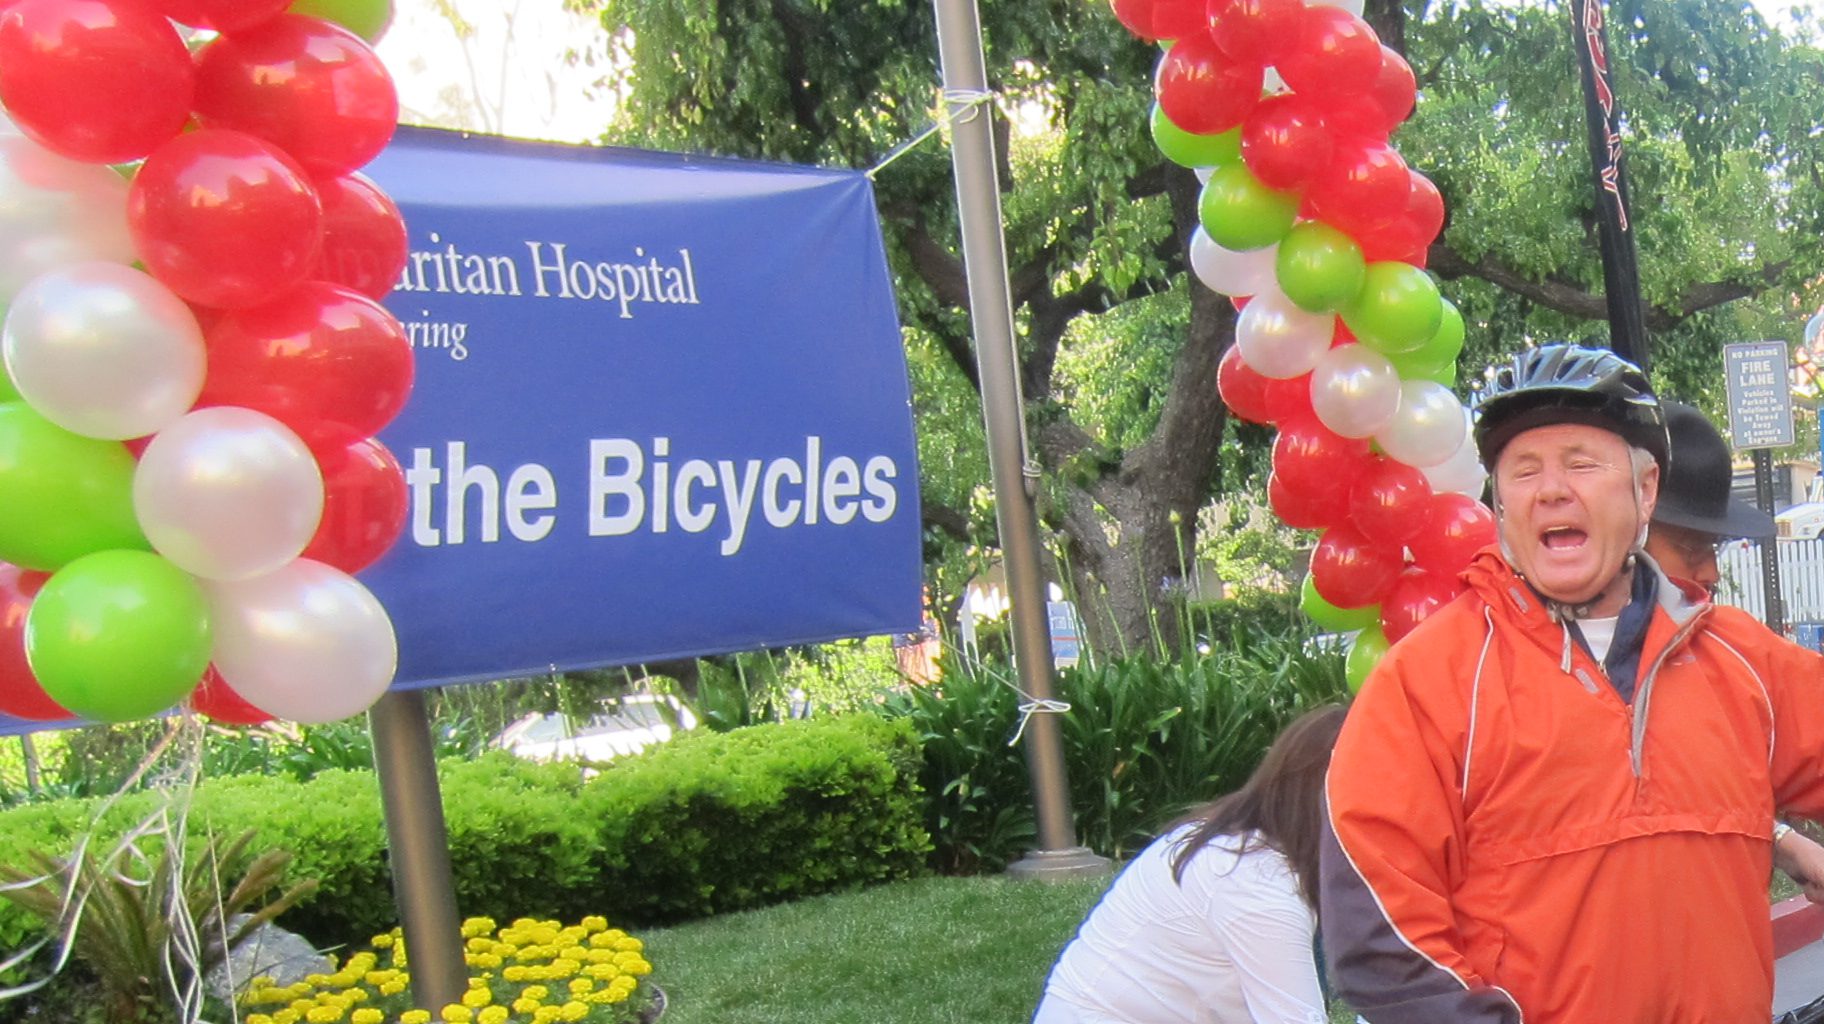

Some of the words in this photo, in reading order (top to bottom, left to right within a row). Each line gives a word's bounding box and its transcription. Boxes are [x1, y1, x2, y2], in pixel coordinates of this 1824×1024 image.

[393, 232, 522, 295] aritan
[525, 240, 700, 319] Hospital
[400, 309, 468, 361] ring
[1732, 351, 1743, 359] NO
[1745, 348, 1778, 357] PARKING
[1741, 361, 1772, 374] FIRE
[1740, 372, 1775, 387] LANE
[406, 440, 557, 548] the
[587, 436, 897, 556] Bicycles
